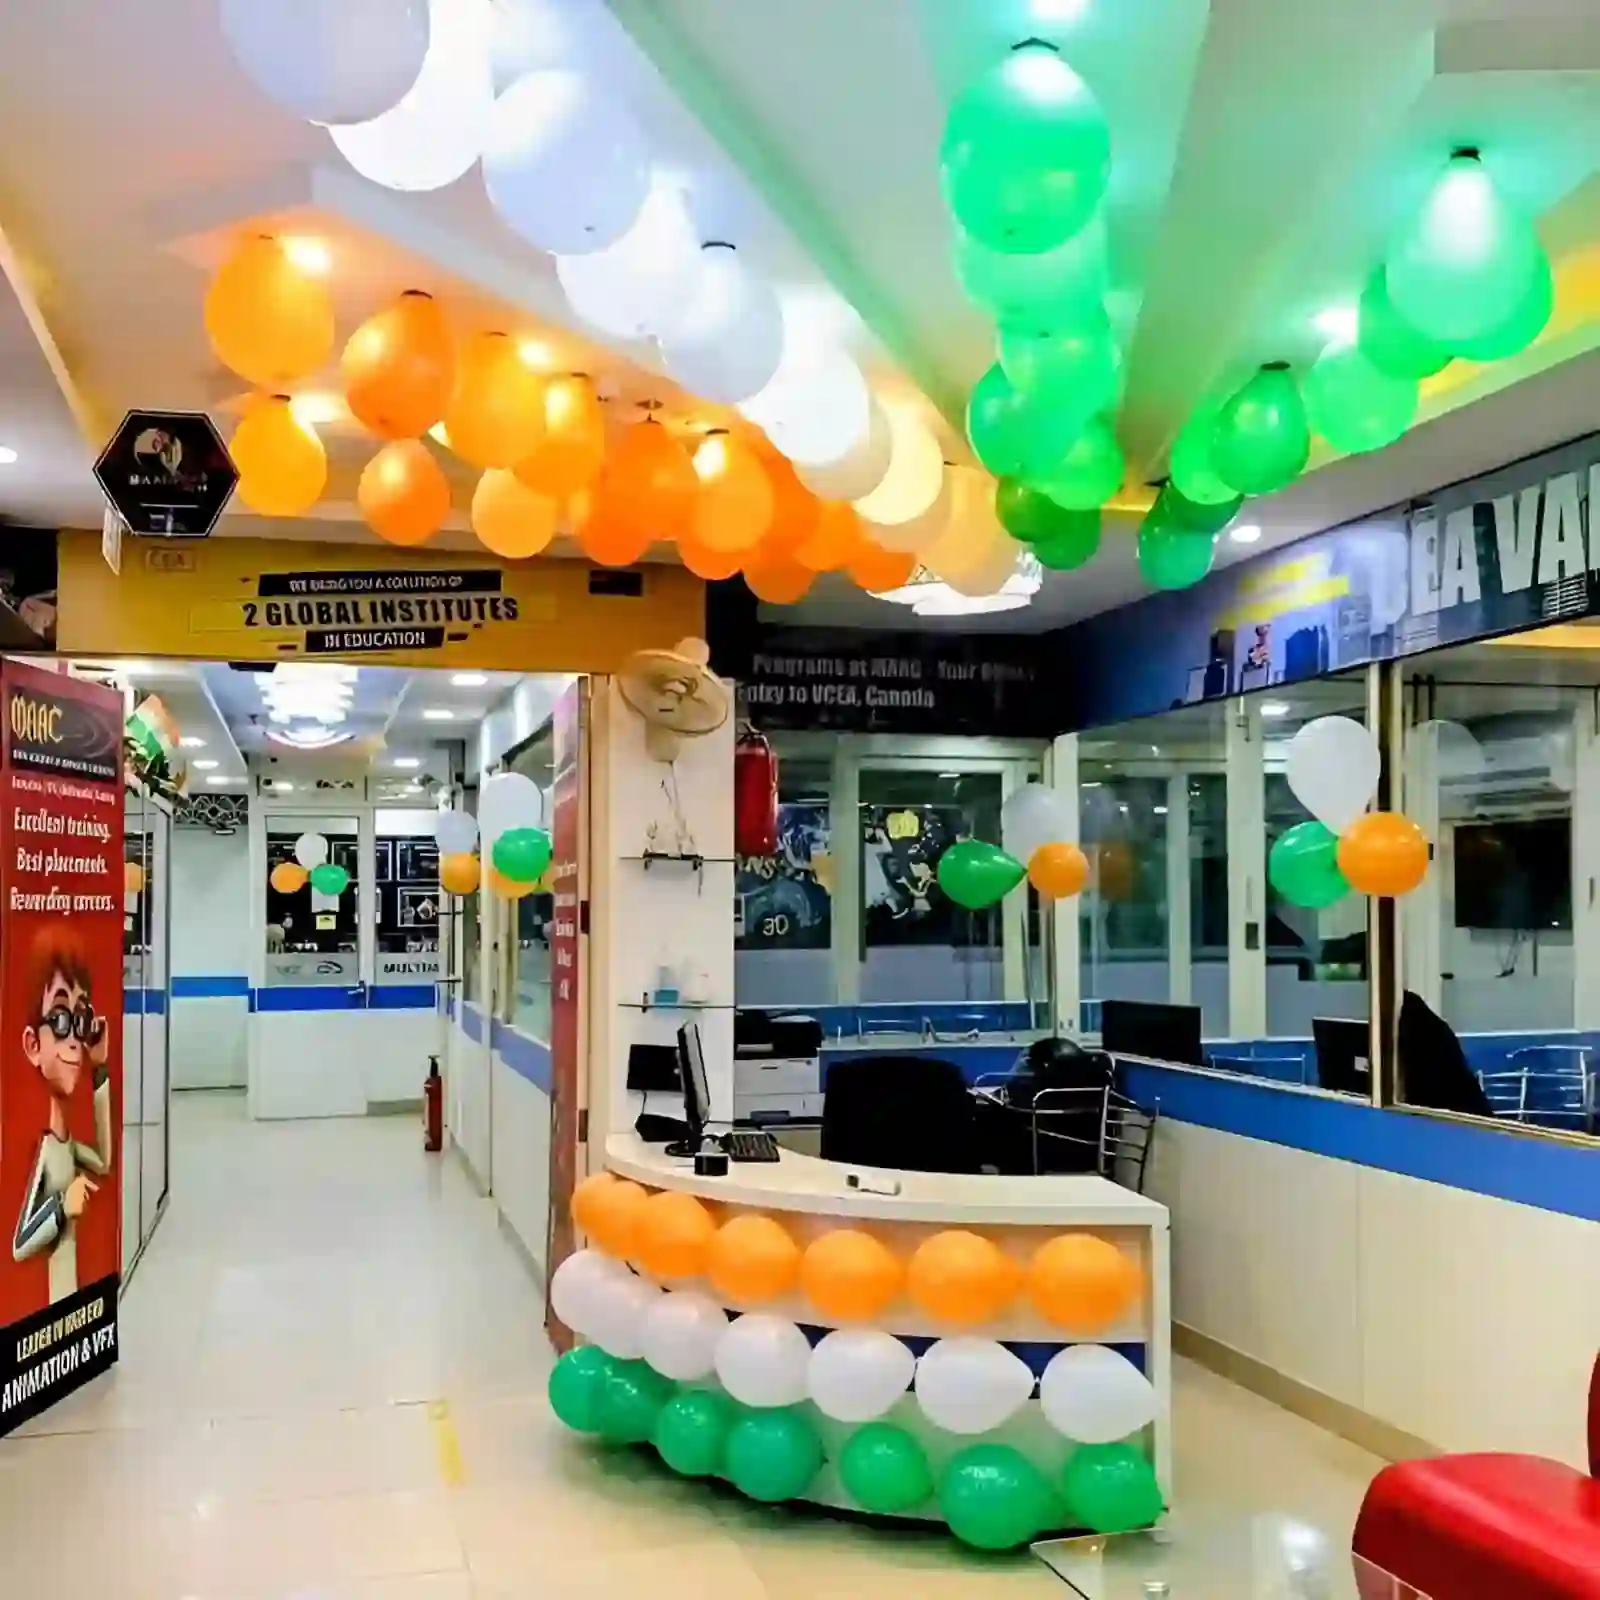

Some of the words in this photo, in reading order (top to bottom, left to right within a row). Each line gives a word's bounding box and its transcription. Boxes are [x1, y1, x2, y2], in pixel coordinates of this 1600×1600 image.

[242, 602, 260, 628] 2
[265, 600, 365, 627] GLOBAL
[368, 597, 519, 624] INSTITUTES
[343, 630, 426, 648] EDUCATION
[2, 1341, 80, 1414] ANIMATION
[80, 1336, 92, 1364] &
[91, 1321, 117, 1356] VFX
